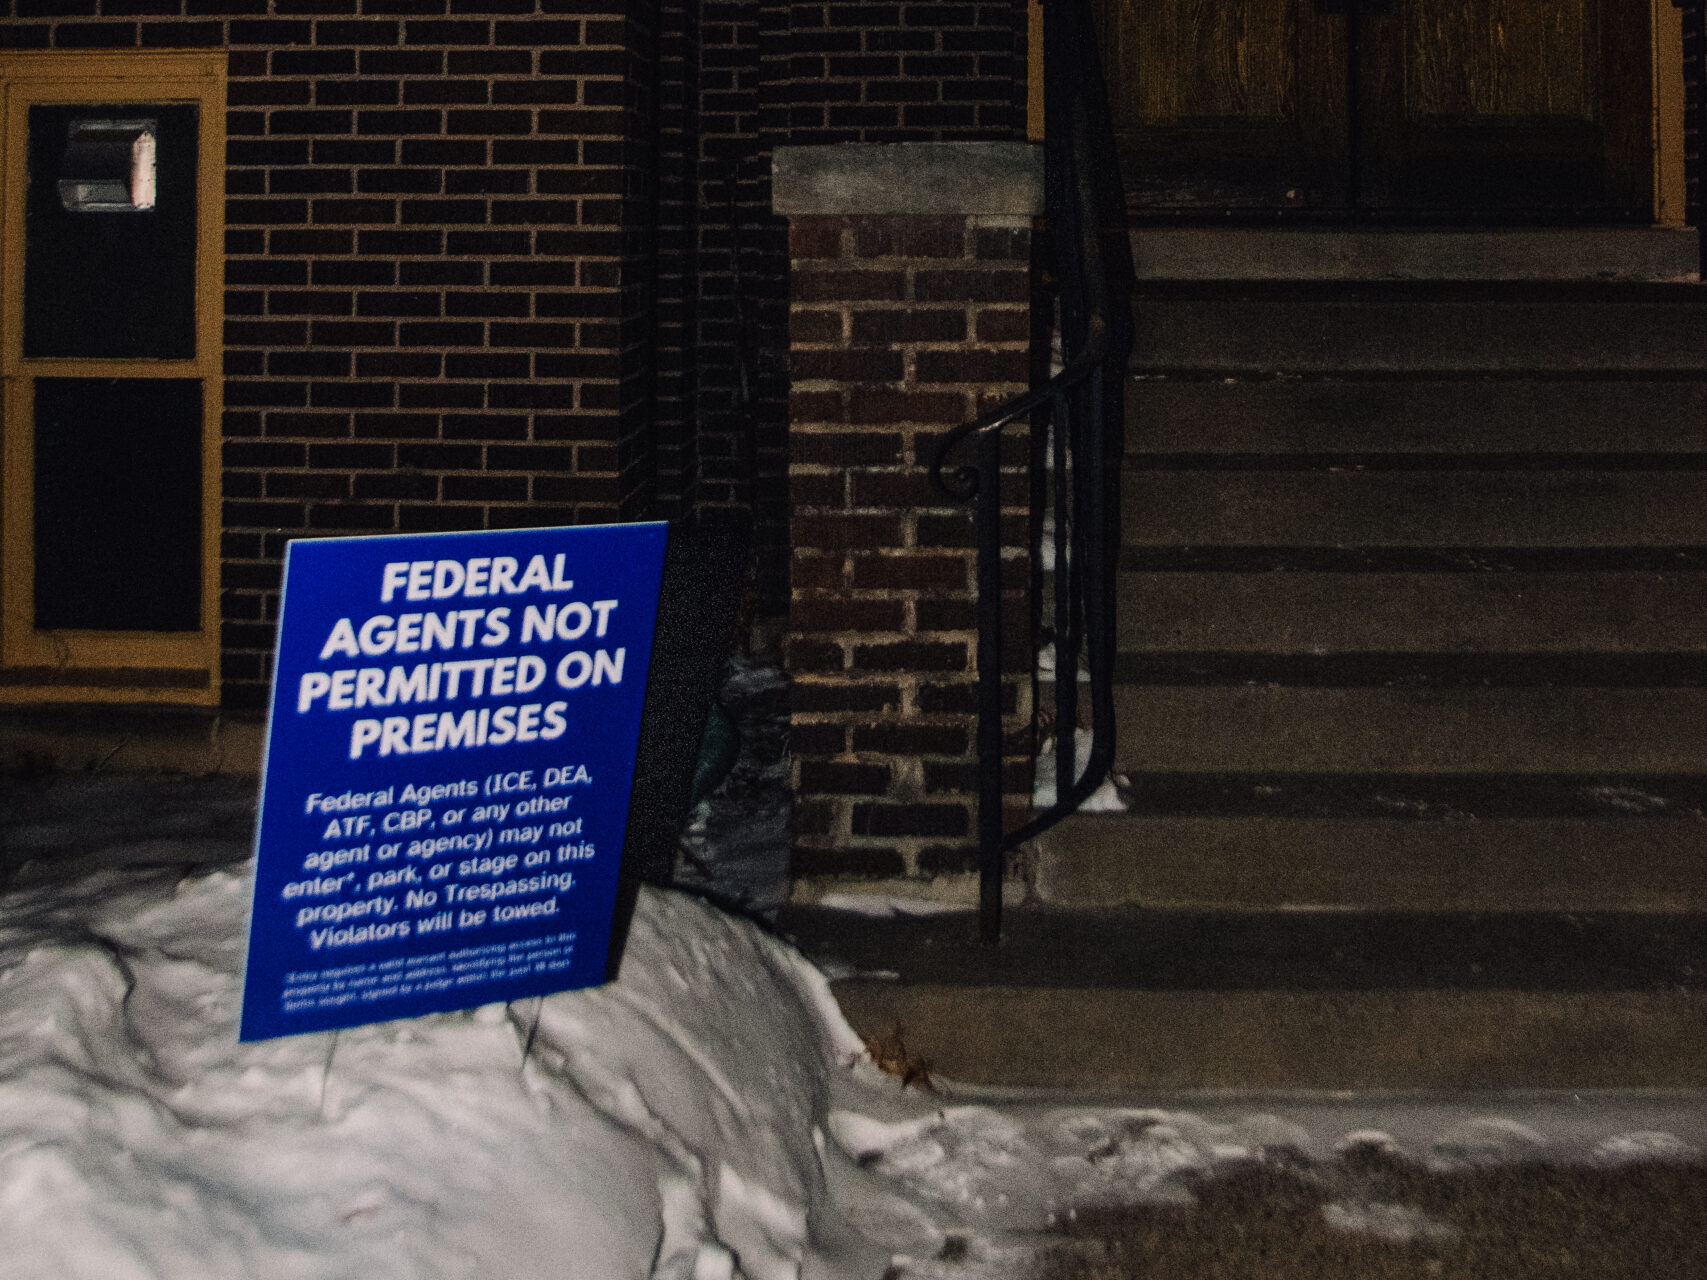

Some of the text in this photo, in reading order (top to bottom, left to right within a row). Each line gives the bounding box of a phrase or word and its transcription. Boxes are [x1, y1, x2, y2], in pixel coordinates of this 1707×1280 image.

[380, 553, 574, 603] FEDERAL
[319, 599, 619, 660] AGENTS NOT
[297, 647, 626, 714] PERMITTED ON
[349, 700, 568, 760] PREMISES
[305, 764, 592, 814] Federal Agents (ICE, DEA,
[323, 795, 572, 839] ATF, CBP, or any other
[303, 818, 582, 872] agent or agency) may not
[367, 865, 422, 892] park,
[428, 863, 452, 880] or
[458, 854, 519, 876] stage
[524, 849, 551, 867] on
[557, 840, 596, 862] this
[296, 871, 576, 928] property. No Trespassing.
[310, 896, 559, 950] Violators will be towed.
